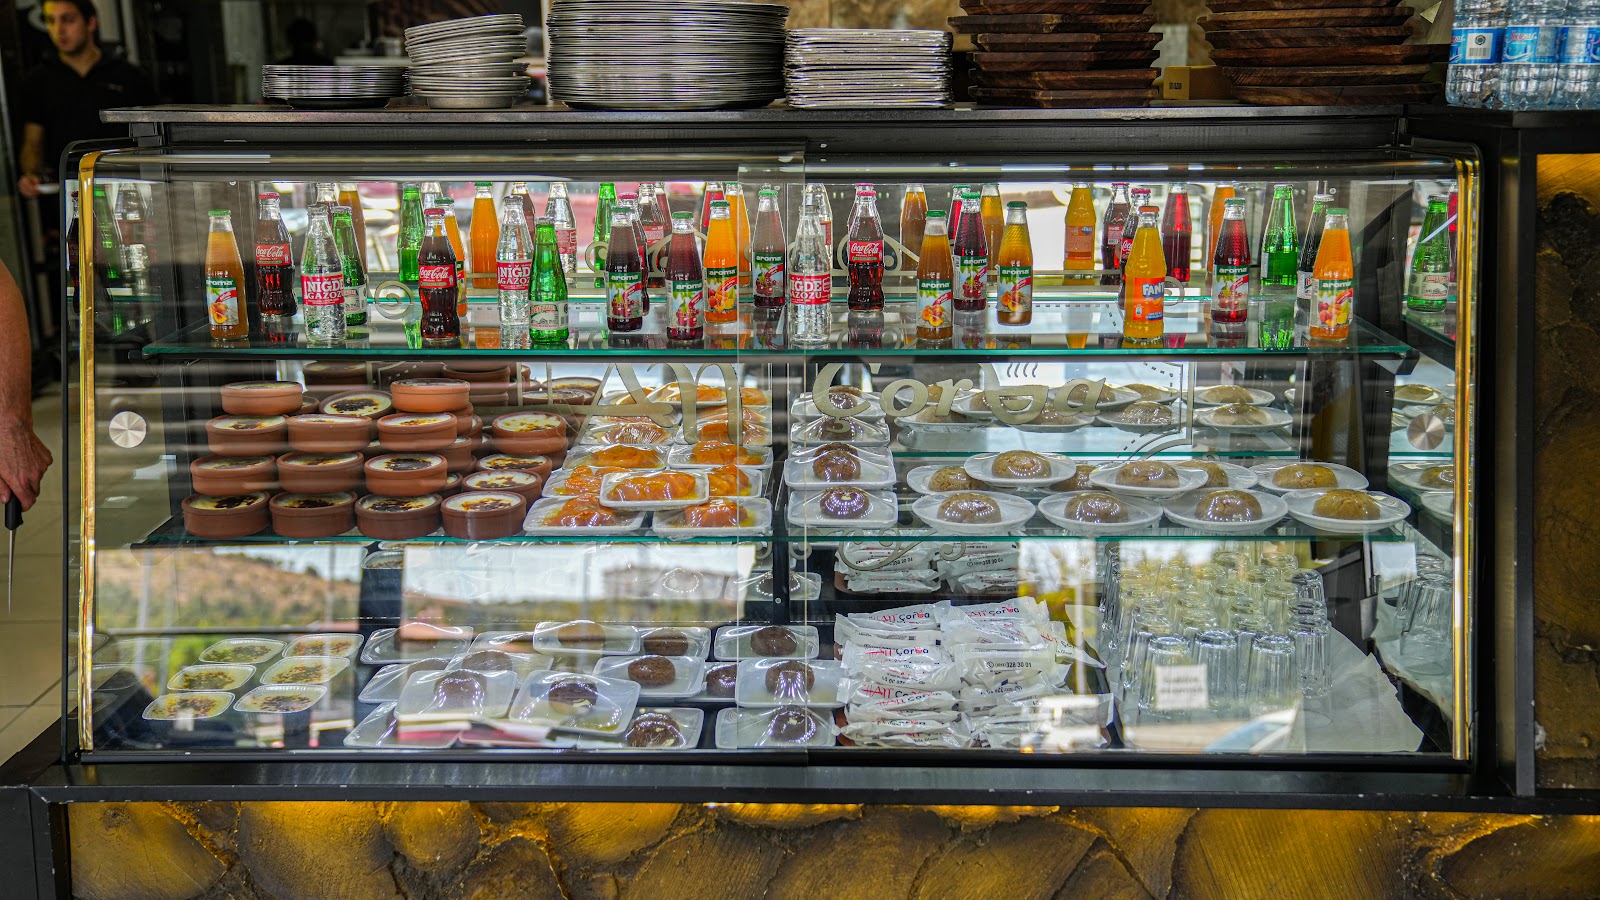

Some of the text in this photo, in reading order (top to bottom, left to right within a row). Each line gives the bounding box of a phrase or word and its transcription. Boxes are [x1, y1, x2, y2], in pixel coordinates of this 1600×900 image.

[708, 268, 738, 276] aroma
[1218, 266, 1248, 274] aroma
[611, 273, 640, 281] aroma
[921, 281, 950, 289] aroma
